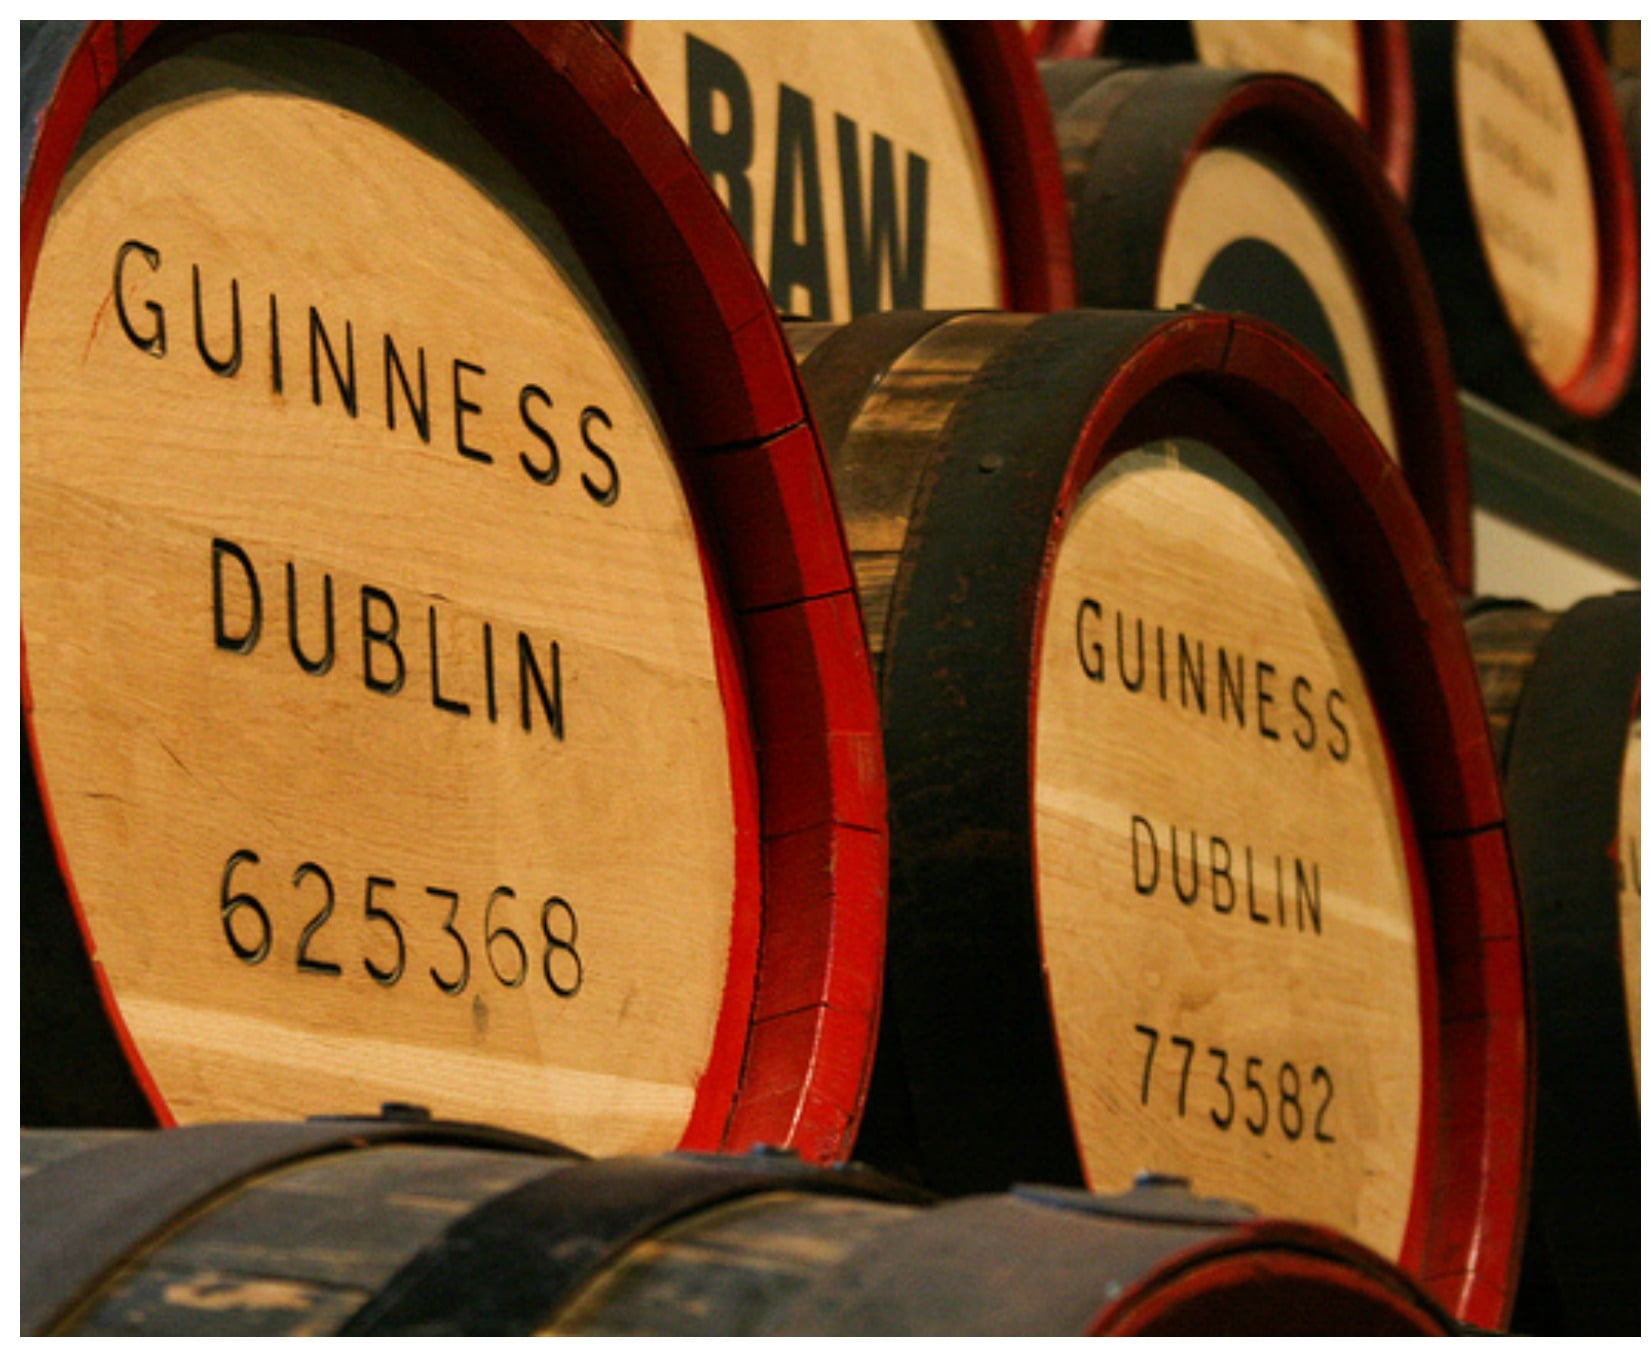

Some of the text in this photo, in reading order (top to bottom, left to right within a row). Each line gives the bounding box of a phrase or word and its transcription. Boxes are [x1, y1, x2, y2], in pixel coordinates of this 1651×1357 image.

[685, 31, 929, 323] RAW
[113, 239, 621, 507] GUINNESS
[211, 537, 565, 741] DUBLIN
[1076, 597, 1351, 763] GUINNESS
[221, 850, 584, 997] 625368
[1131, 815, 1323, 936] DUBLIN
[1134, 1025, 1336, 1143] 773582
